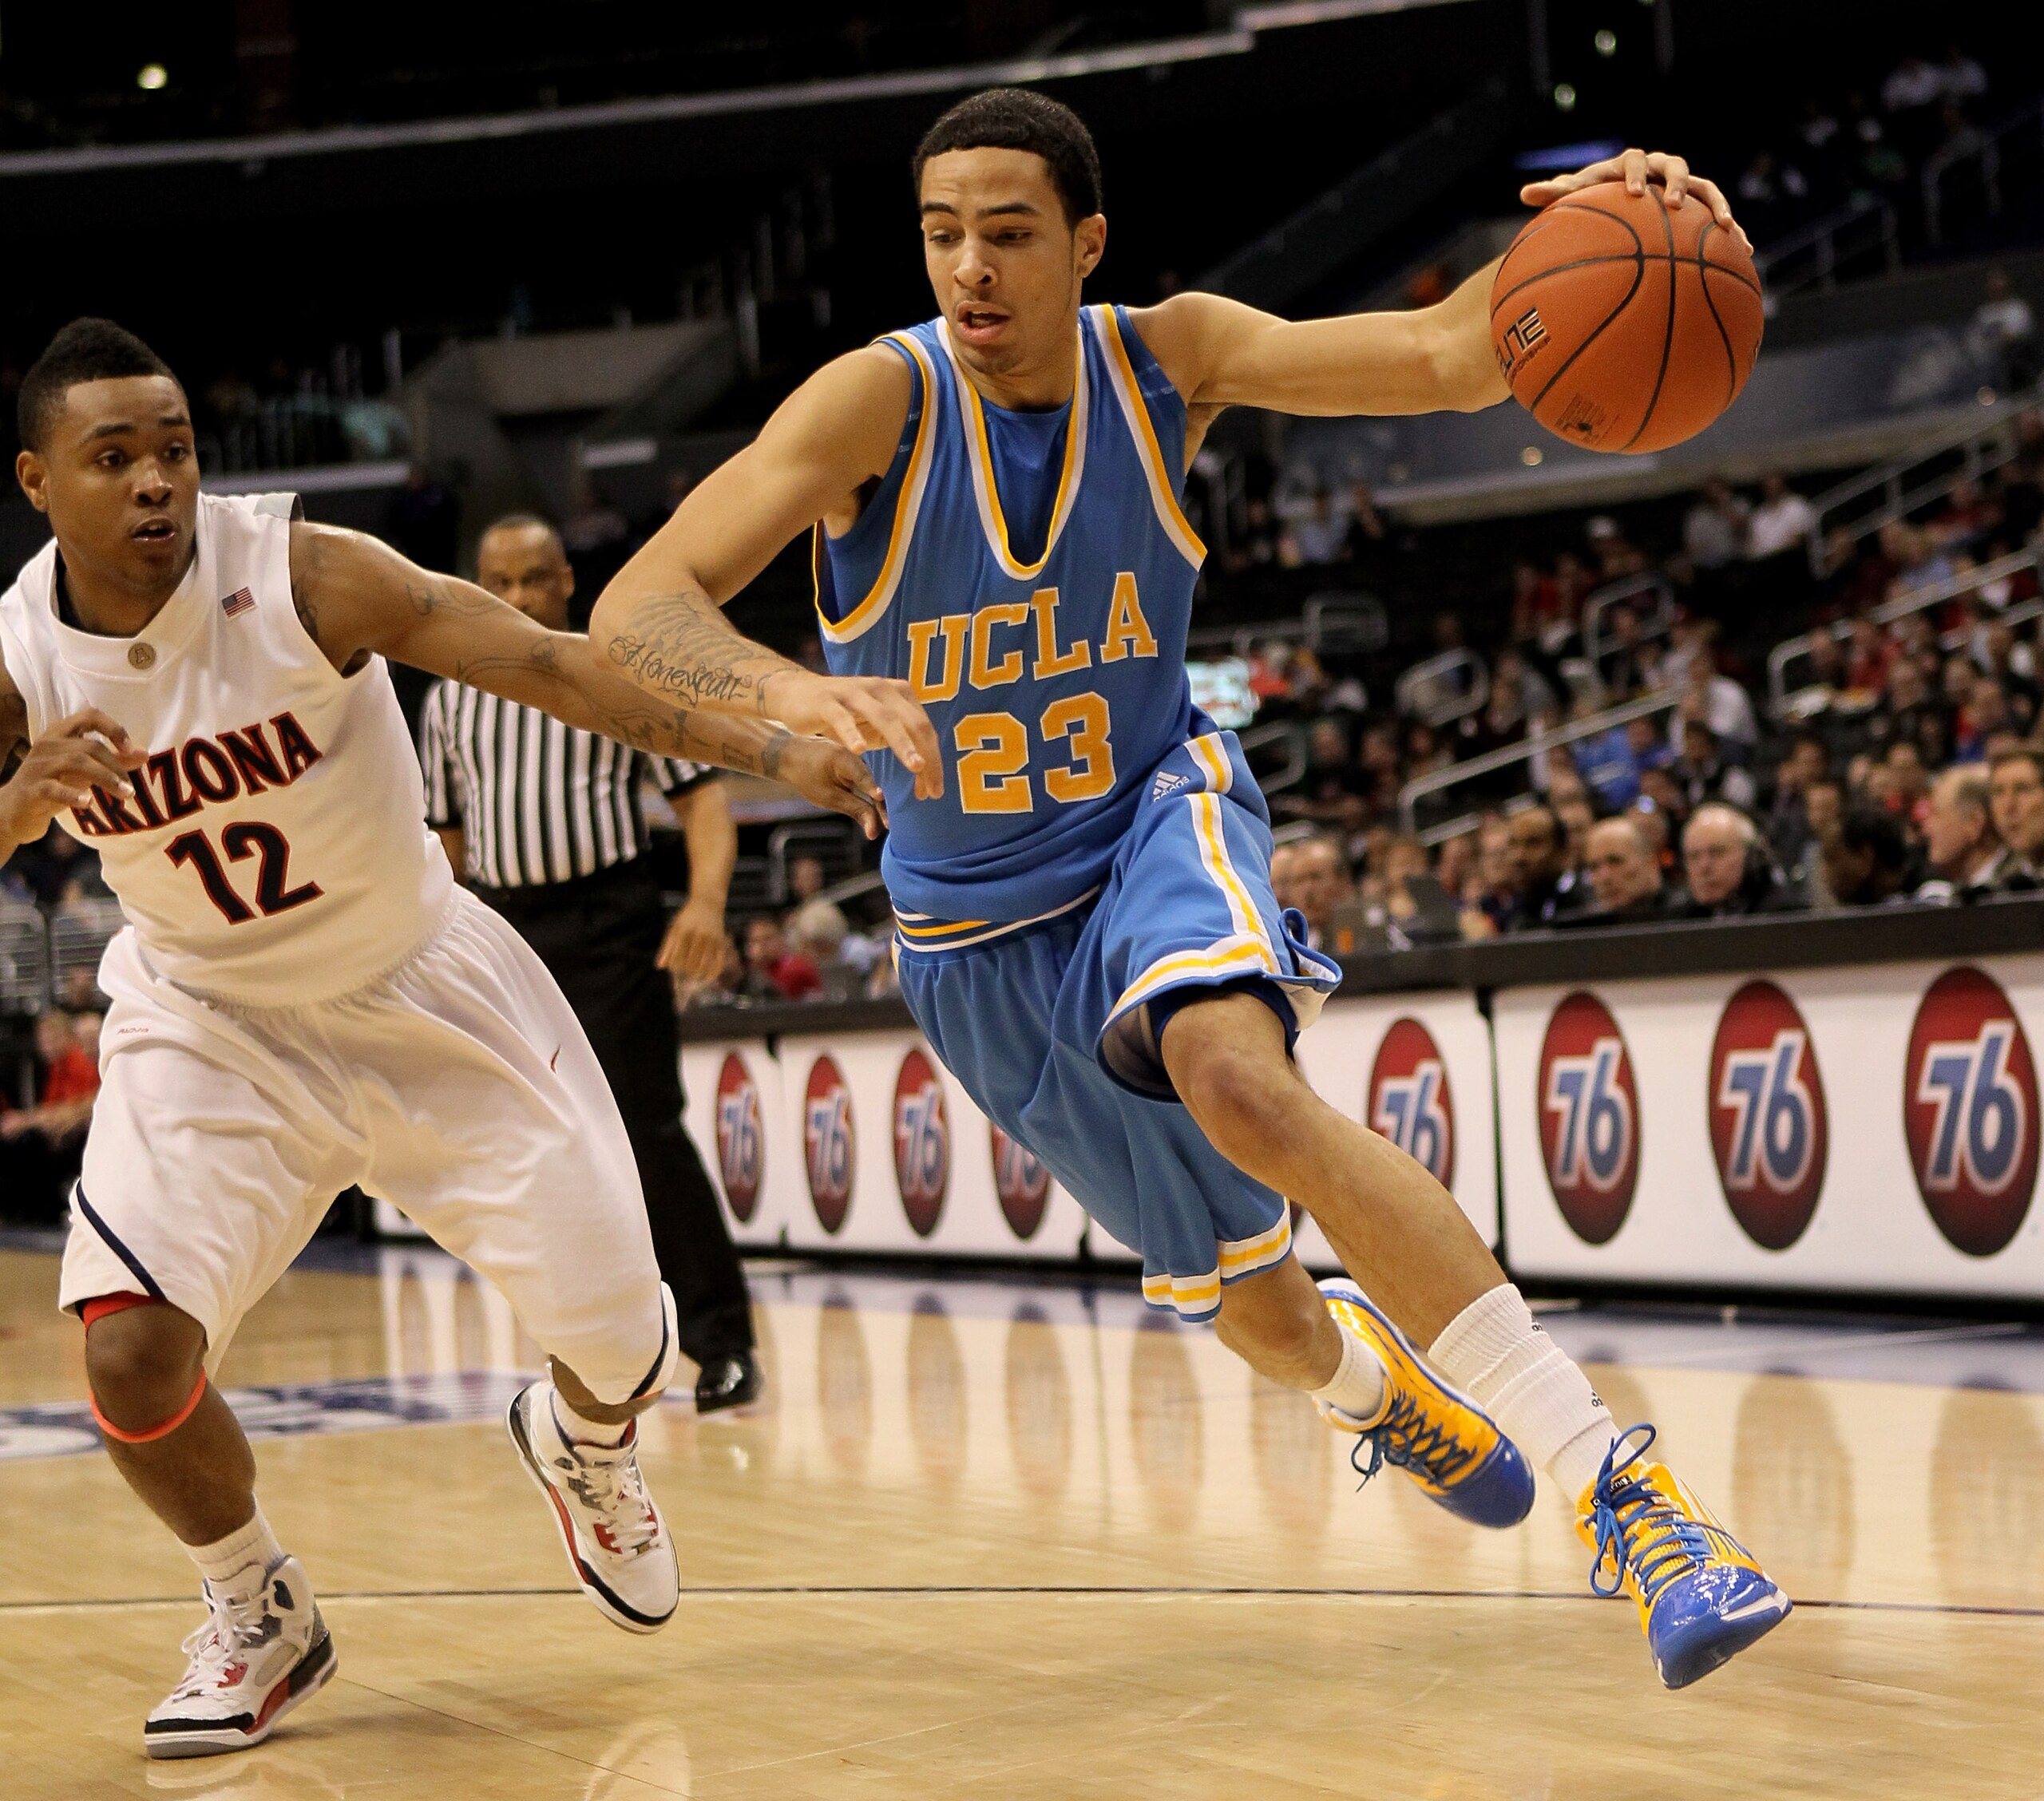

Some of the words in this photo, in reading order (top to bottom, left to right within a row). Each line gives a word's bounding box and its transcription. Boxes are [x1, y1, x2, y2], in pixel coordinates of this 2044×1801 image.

[907, 572, 1159, 704] UCLA
[953, 691, 1117, 814] 23
[164, 821, 326, 926] 12
[722, 1081, 762, 1189] 76
[807, 1085, 854, 1195] 76
[895, 1083, 948, 1196] 76
[1374, 1057, 1452, 1182] 76
[1547, 1039, 1633, 1192] 76
[1719, 1030, 1816, 1194] 76
[1919, 1019, 2026, 1196] 76
